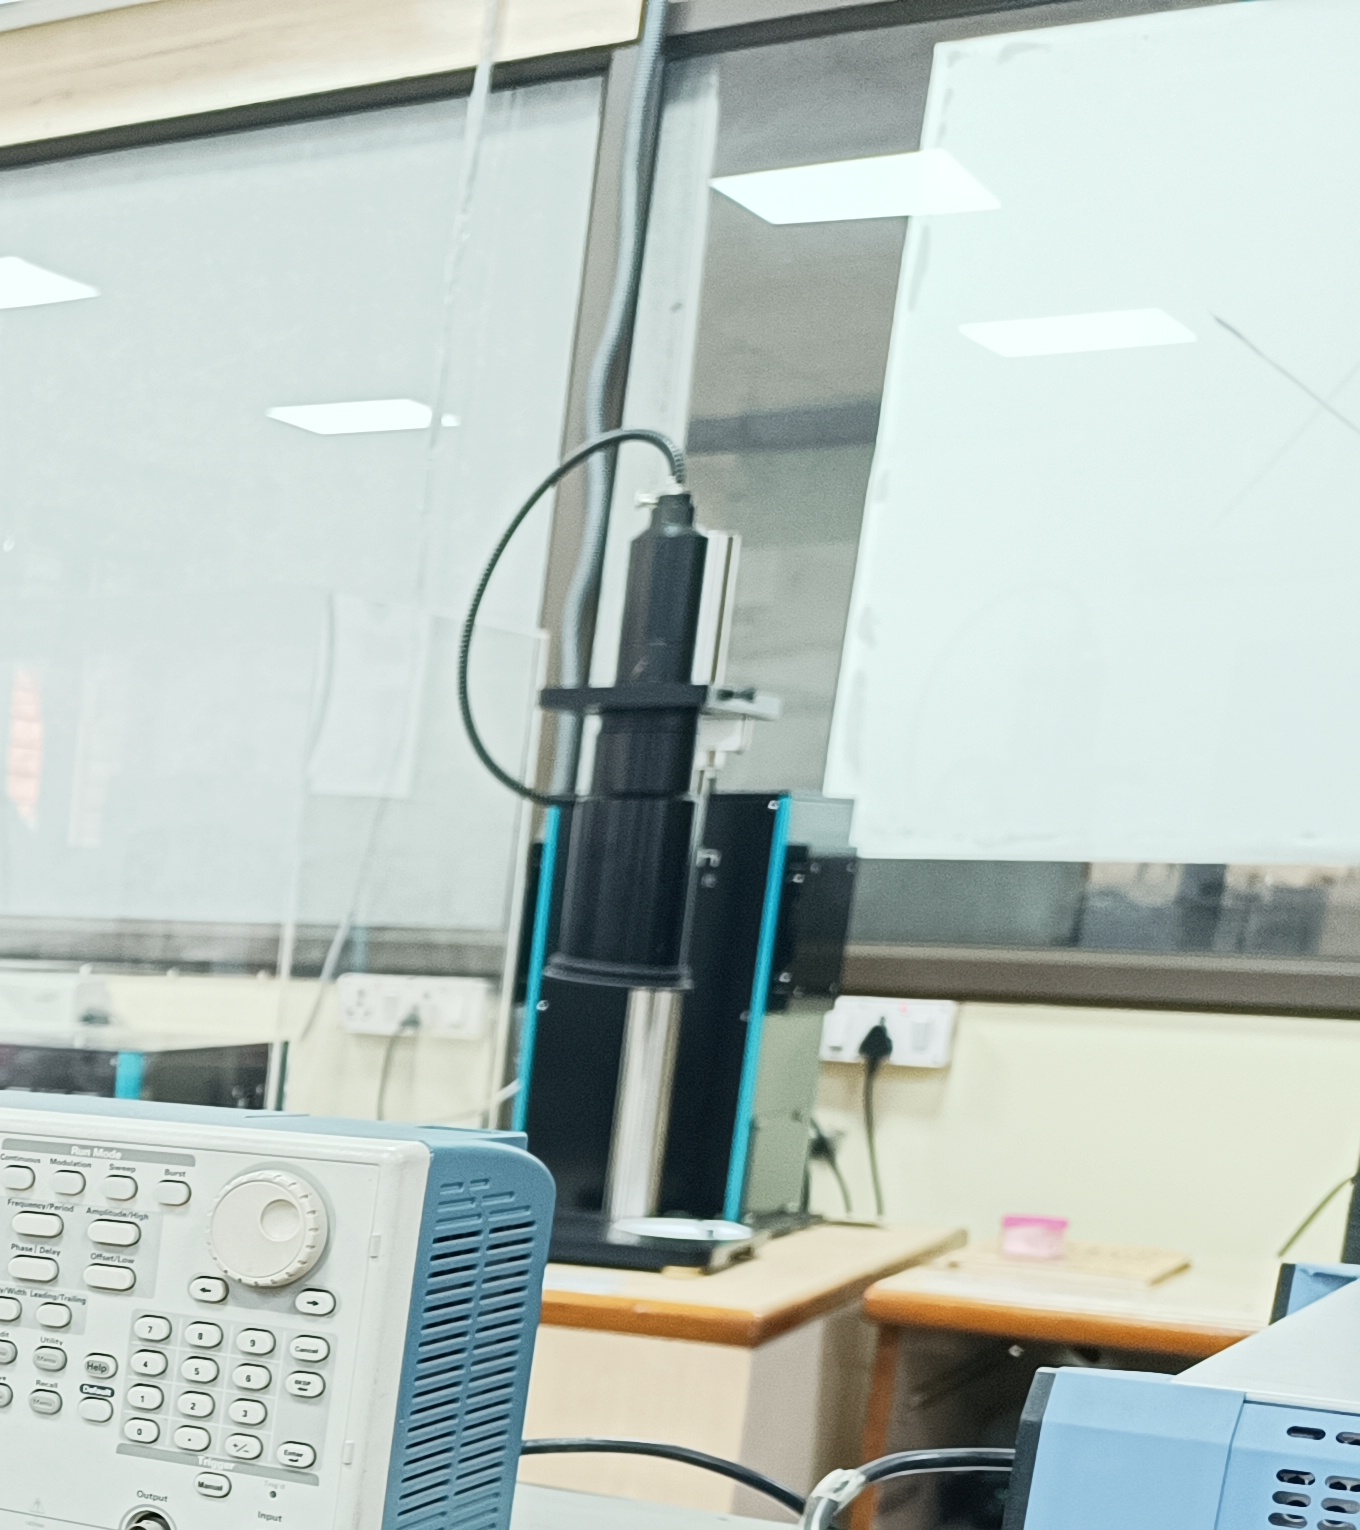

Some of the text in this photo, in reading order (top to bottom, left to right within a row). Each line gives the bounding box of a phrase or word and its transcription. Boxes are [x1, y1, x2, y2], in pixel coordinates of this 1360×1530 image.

[0, 1153, 40, 1164] Continuous
[71, 1147, 122, 1159] Run Mode
[50, 1158, 91, 1168] Modulation
[109, 1164, 136, 1173] Sweep
[165, 1169, 186, 1177] Burst
[8, 1199, 73, 1212] Frequency/Period
[86, 1207, 149, 1220] Amplitude/High
[11, 1243, 60, 1256] Phase Delay
[91, 1253, 134, 1264] Offset/Low
[30, 1290, 86, 1305] Leading/Trailing
[40, 1337, 63, 1345] Utility
[86, 1362, 107, 1373] Help
[36, 1380, 58, 1389] Recall
[284, 1449, 303, 1457] Enter
[197, 1455, 236, 1470] Trigger
[197, 1480, 223, 1491] Manual
[137, 1490, 168, 1502] Output
[258, 1511, 282, 1522] Input
